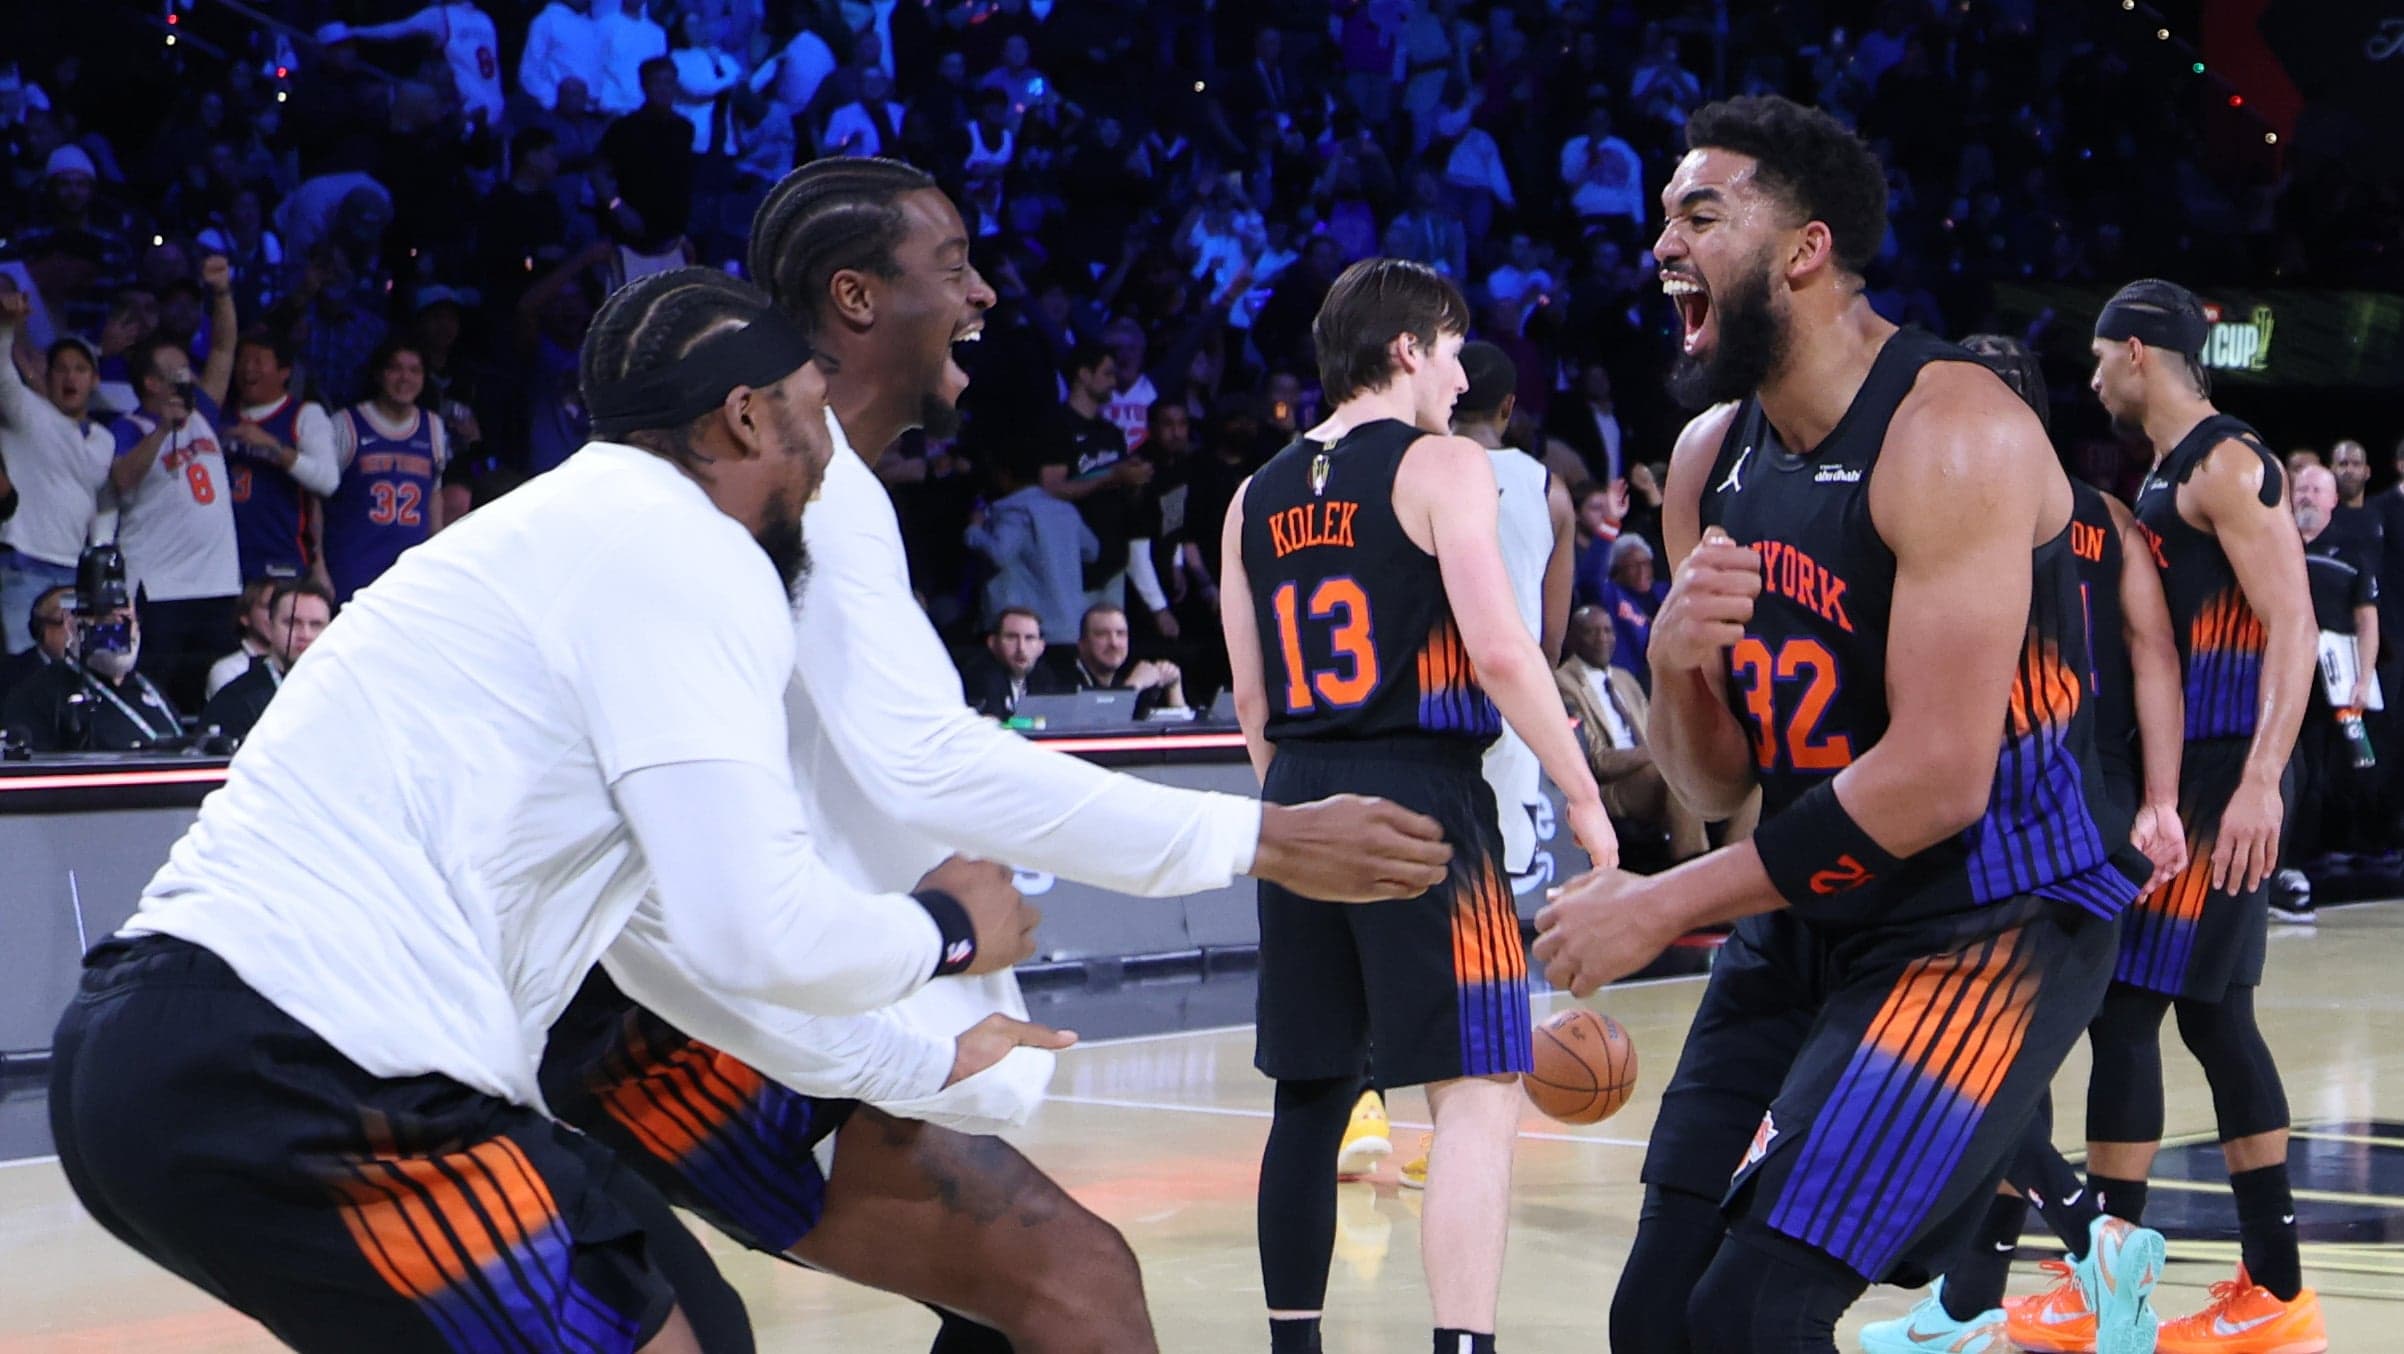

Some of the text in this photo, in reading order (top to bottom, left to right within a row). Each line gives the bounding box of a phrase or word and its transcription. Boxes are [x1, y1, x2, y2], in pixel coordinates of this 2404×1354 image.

[2213, 323, 2259, 367] CUP
[186, 463, 216, 506] 8
[368, 481, 421, 526] 32
[1269, 501, 1359, 558] KOLEK
[1272, 574, 1381, 715] 13
[1732, 635, 1853, 774] 32
